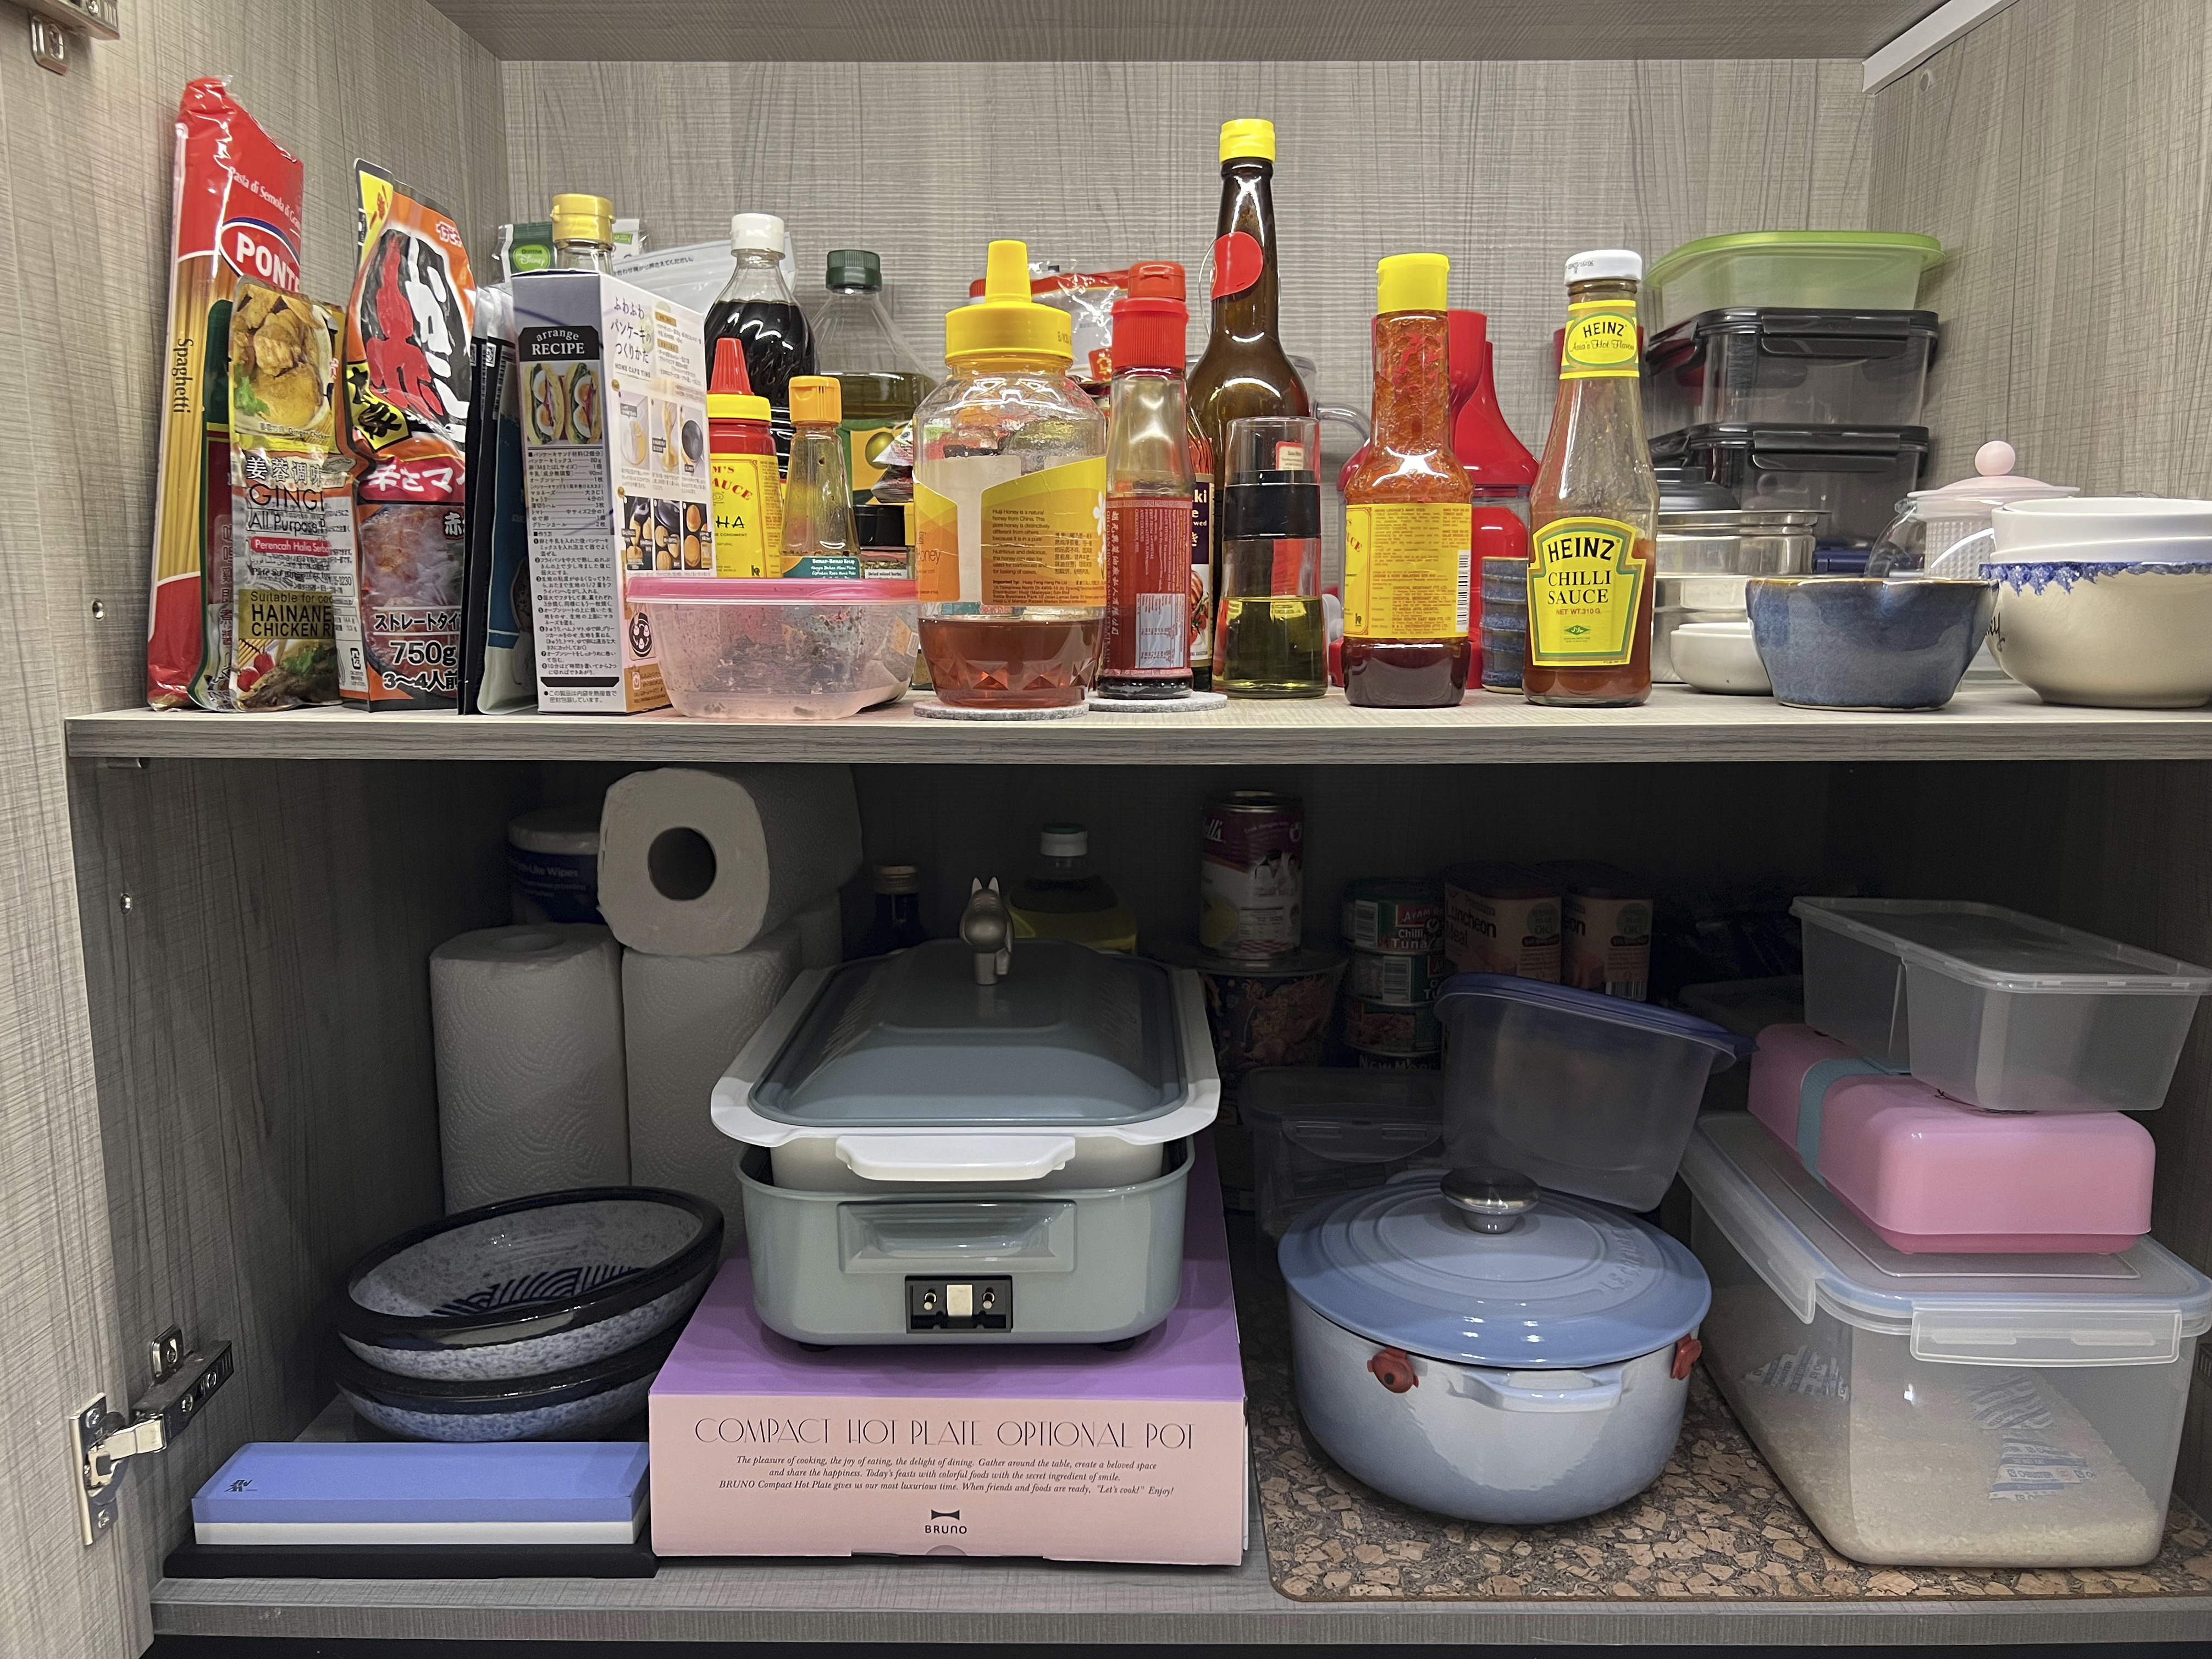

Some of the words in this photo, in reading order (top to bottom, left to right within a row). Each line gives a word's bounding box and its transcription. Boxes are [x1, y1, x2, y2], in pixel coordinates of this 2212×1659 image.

[228, 166, 249, 189] Pasta
[251, 180, 260, 194] di
[259, 186, 284, 212] Semola
[518, 255, 545, 266] Disney
[613, 296, 644, 320] ふわふわ
[536, 330, 579, 342] arrange
[611, 318, 651, 344] パンケーキの
[1583, 321, 1625, 338] HEINZ
[531, 342, 585, 355] RECIPE
[1591, 339, 1610, 350] Hot
[615, 343, 649, 364] つくりかた
[173, 337, 194, 414] Spaghetti
[615, 363, 628, 372] HOME
[628, 367, 640, 375] CAFE
[640, 370, 651, 378] TIME
[289, 428, 310, 438] Ginger
[367, 464, 465, 493] 辛さマ
[1192, 489, 1208, 504] ki
[255, 539, 291, 550] Perencah
[293, 541, 312, 552] Halia
[1547, 537, 1615, 563] HEINZ
[1548, 569, 1612, 587] CHILLI
[251, 591, 298, 602] Suitable
[302, 593, 315, 602] for
[1547, 588, 1609, 605] SAUCE
[251, 622, 318, 637] CHICKEN
[374, 612, 461, 632] ストレートタイ
[389, 639, 458, 667] 750g
[546, 865, 579, 879] Wipes
[1402, 908, 1431, 923] AYAM
[1446, 900, 1497, 938] Luncheon
[1398, 928, 1424, 939] Chilli
[1390, 938, 1428, 949] Tuna
[694, 1417, 832, 1444] COMPACT
[848, 1418, 899, 1445] HOT
[911, 1419, 983, 1446] PLATE
[997, 1420, 1133, 1448] OPTIONAL
[1146, 1422, 1196, 1450] POT
[737, 1456, 751, 1464] The
[753, 1456, 785, 1466] pleasure
[787, 1456, 798, 1467] of
[797, 1456, 828, 1467] cooking,
[830, 1456, 842, 1465] the
[843, 1457, 856, 1467] joy
[858, 1456, 867, 1467] of
[867, 1457, 893, 1468] eating,
[895, 1457, 908, 1466] the
[909, 1457, 936, 1468] delight
[938, 1457, 947, 1468] of
[947, 1457, 975, 1469] dining.
[978, 1458, 1006, 1467] Gather
[1008, 1458, 1036, 1468] around
[1037, 1458, 1050, 1468] the
[1051, 1459, 1073, 1469] table,
[1074, 1461, 1097, 1469] create
[1106, 1460, 1135, 1470] beloved
[1136, 1462, 1158, 1472] space
[768, 1468, 785, 1477] and
[786, 1468, 807, 1477] share
[809, 1468, 821, 1477] the
[823, 1468, 862, 1479] happiness.
[866, 1468, 893, 1479] Today's
[894, 1469, 916, 1480] feasts
[918, 1469, 937, 1478] with
[938, 1469, 969, 1481] colorful
[969, 1470, 989, 1481] foods
[991, 1470, 1010, 1479] with
[1012, 1471, 1024, 1480] the
[1025, 1472, 1047, 1480] secret
[1048, 1472, 1087, 1483] ingredient
[1088, 1472, 1099, 1483] of
[1098, 1472, 1121, 1482] smile.
[718, 1480, 756, 1489] BRUNO
[757, 1480, 793, 1490] Compact
[794, 1480, 810, 1489] Hot
[811, 1480, 832, 1489] Plate
[833, 1481, 853, 1491] gives
[880, 1482, 899, 1490] most
[900, 1481, 937, 1491] luxurious
[939, 1481, 959, 1491] time.
[962, 1482, 985, 1491] When
[985, 1483, 1013, 1494] friends
[1015, 1483, 1031, 1492] and
[1030, 1483, 1052, 1494] foods
[1068, 1484, 1092, 1495] ready,
[1147, 1486, 1175, 1498] Enjoy!
[925, 1525, 967, 1534] BRUNO
